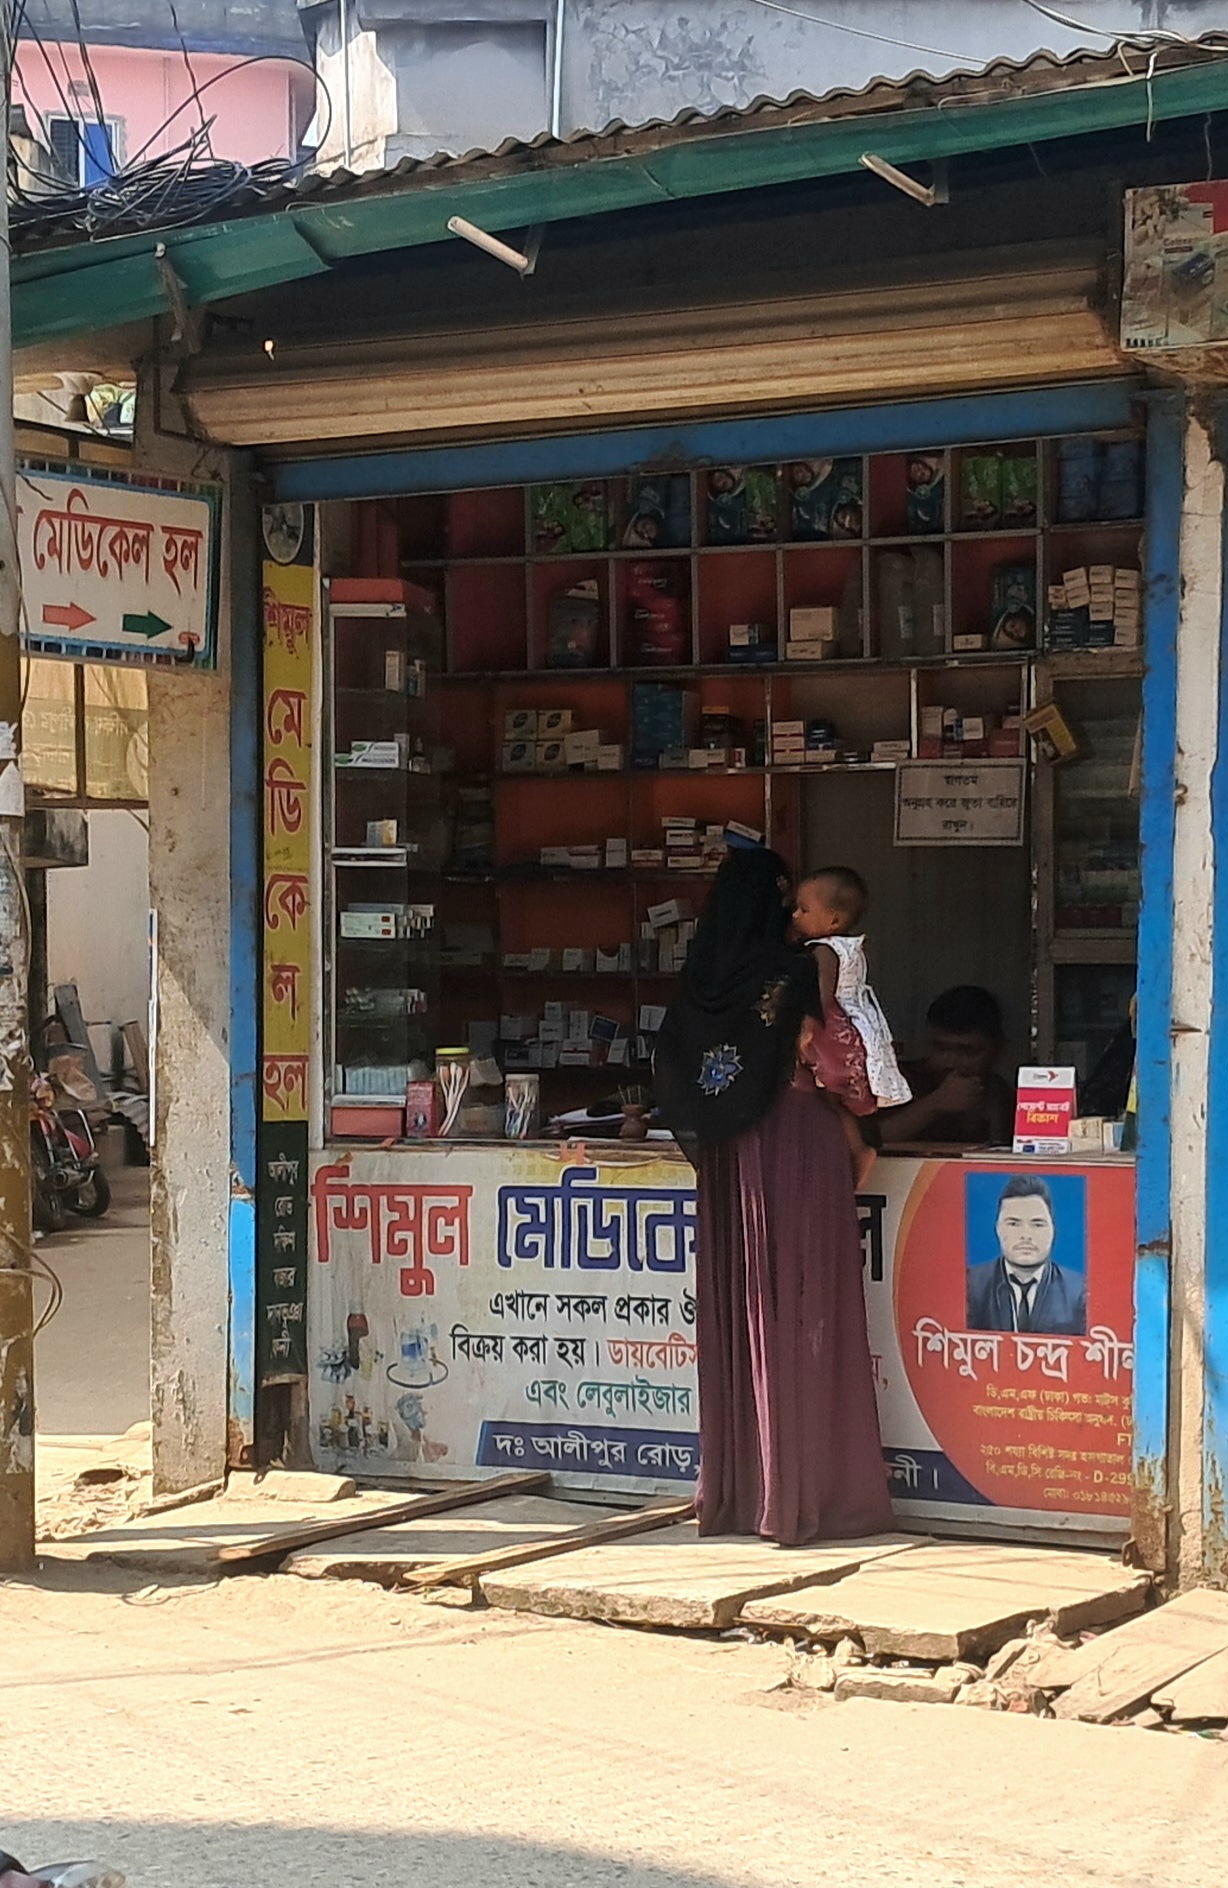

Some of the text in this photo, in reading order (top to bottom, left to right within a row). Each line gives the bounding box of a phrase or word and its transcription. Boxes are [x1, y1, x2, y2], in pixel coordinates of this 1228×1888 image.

[33, 487, 204, 597] মেডিকেল হল
[263, 1054, 310, 1112] হল
[311, 1164, 474, 1297] শিমুল
[497, 1166, 698, 1274] মেডিকে
[489, 1291, 549, 1323] এখানে
[556, 1294, 607, 1324] সকল
[614, 1296, 672, 1327] প্রকার
[449, 1324, 505, 1364] বিক্রয়
[511, 1335, 548, 1366] করা
[912, 1316, 1004, 1382] শিমুল
[1011, 1336, 1074, 1383] চন্দ্র
[525, 1374, 693, 1418] এবং লেবুলাইজার
[531, 1430, 628, 1468] আলীপুর
